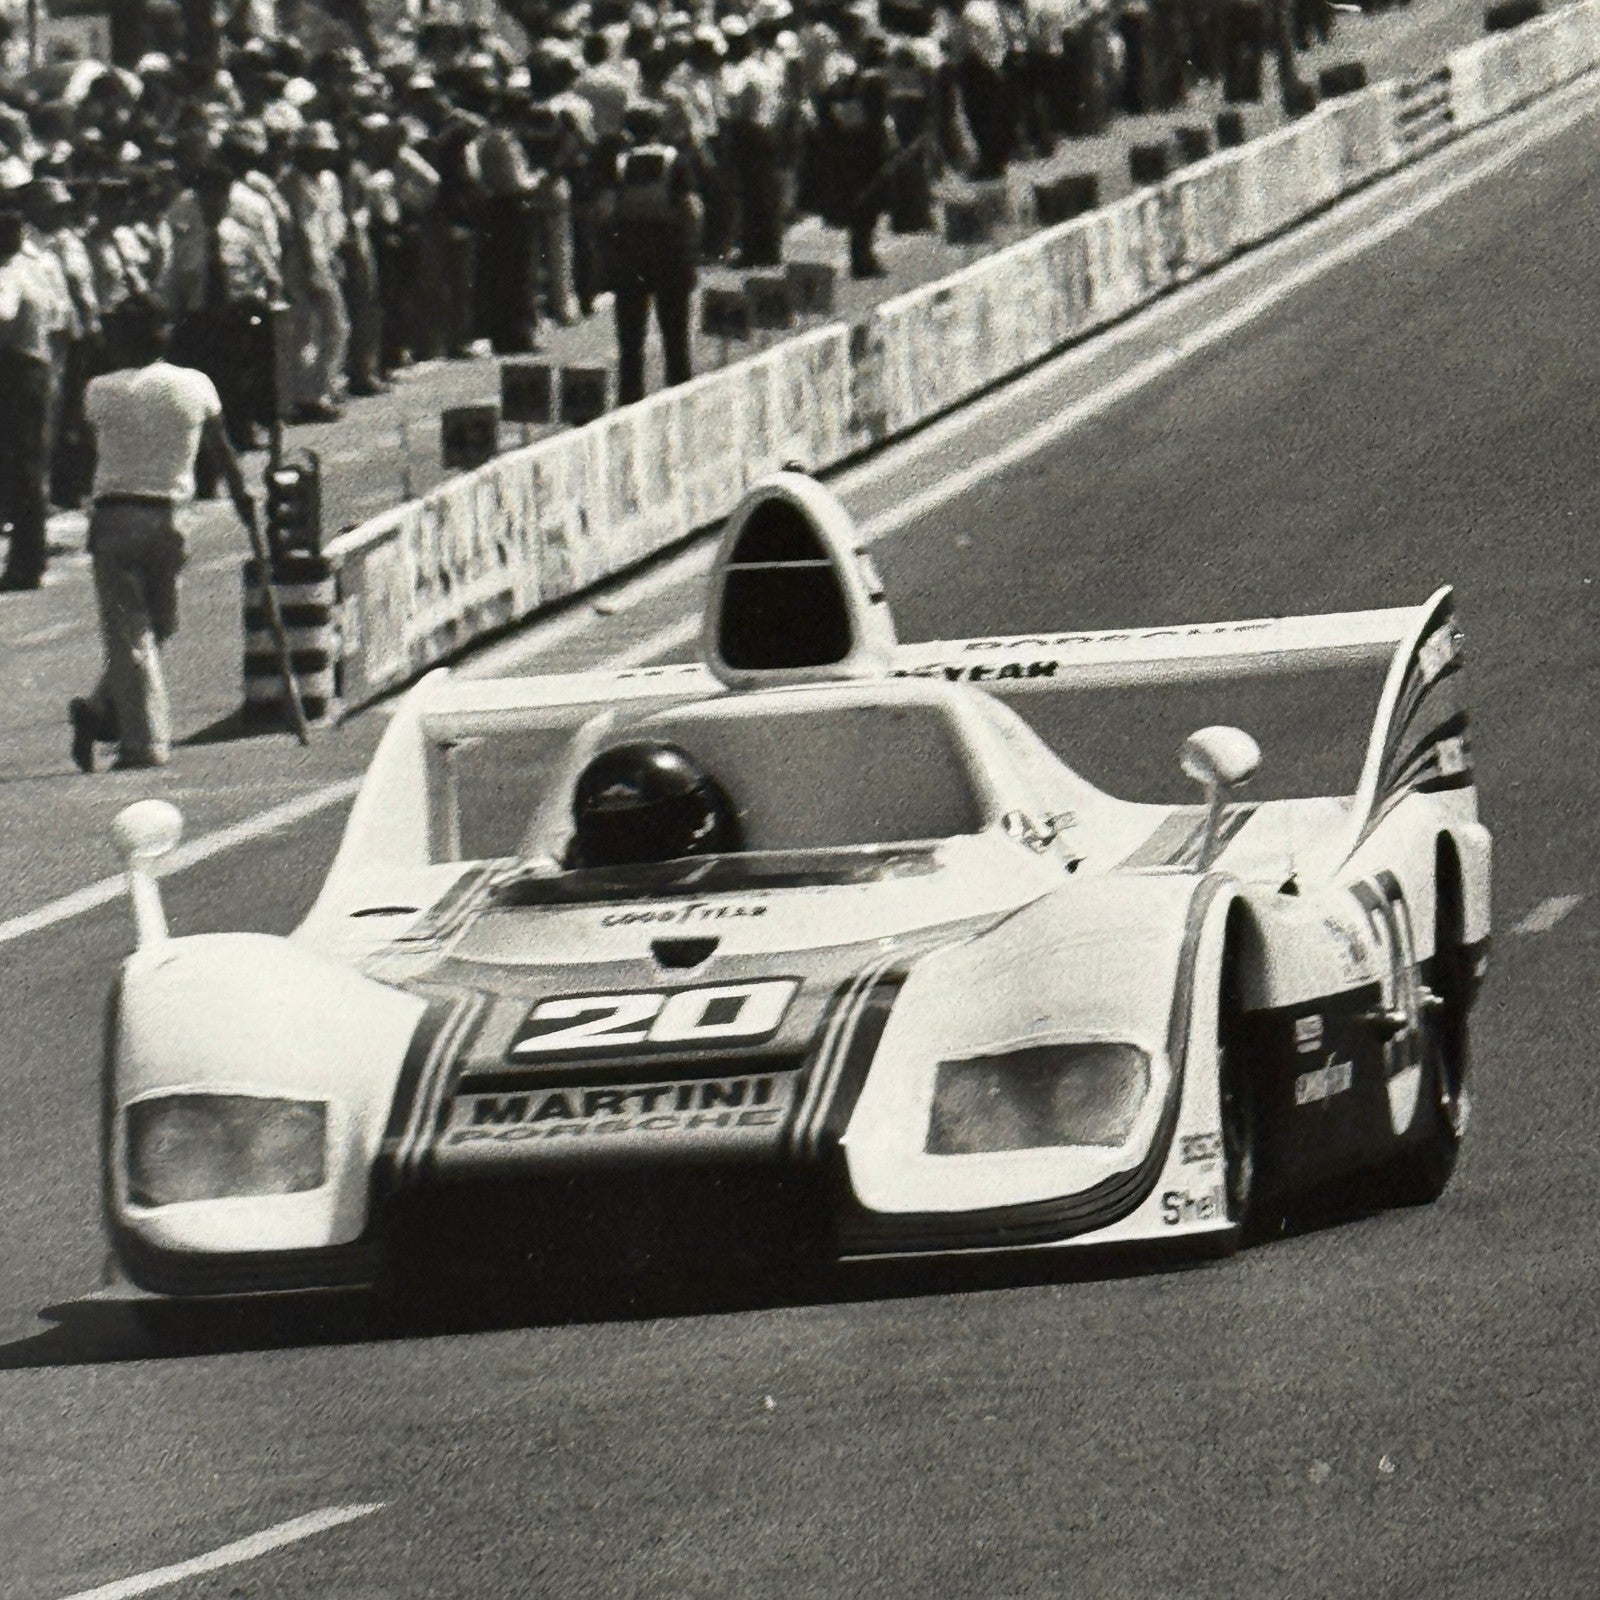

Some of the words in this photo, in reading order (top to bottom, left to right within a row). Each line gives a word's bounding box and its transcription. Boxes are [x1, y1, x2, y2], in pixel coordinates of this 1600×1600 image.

[509, 978, 800, 1057] 20
[471, 1076, 774, 1125] MARTINI
[450, 1107, 783, 1146] PORSCHE
